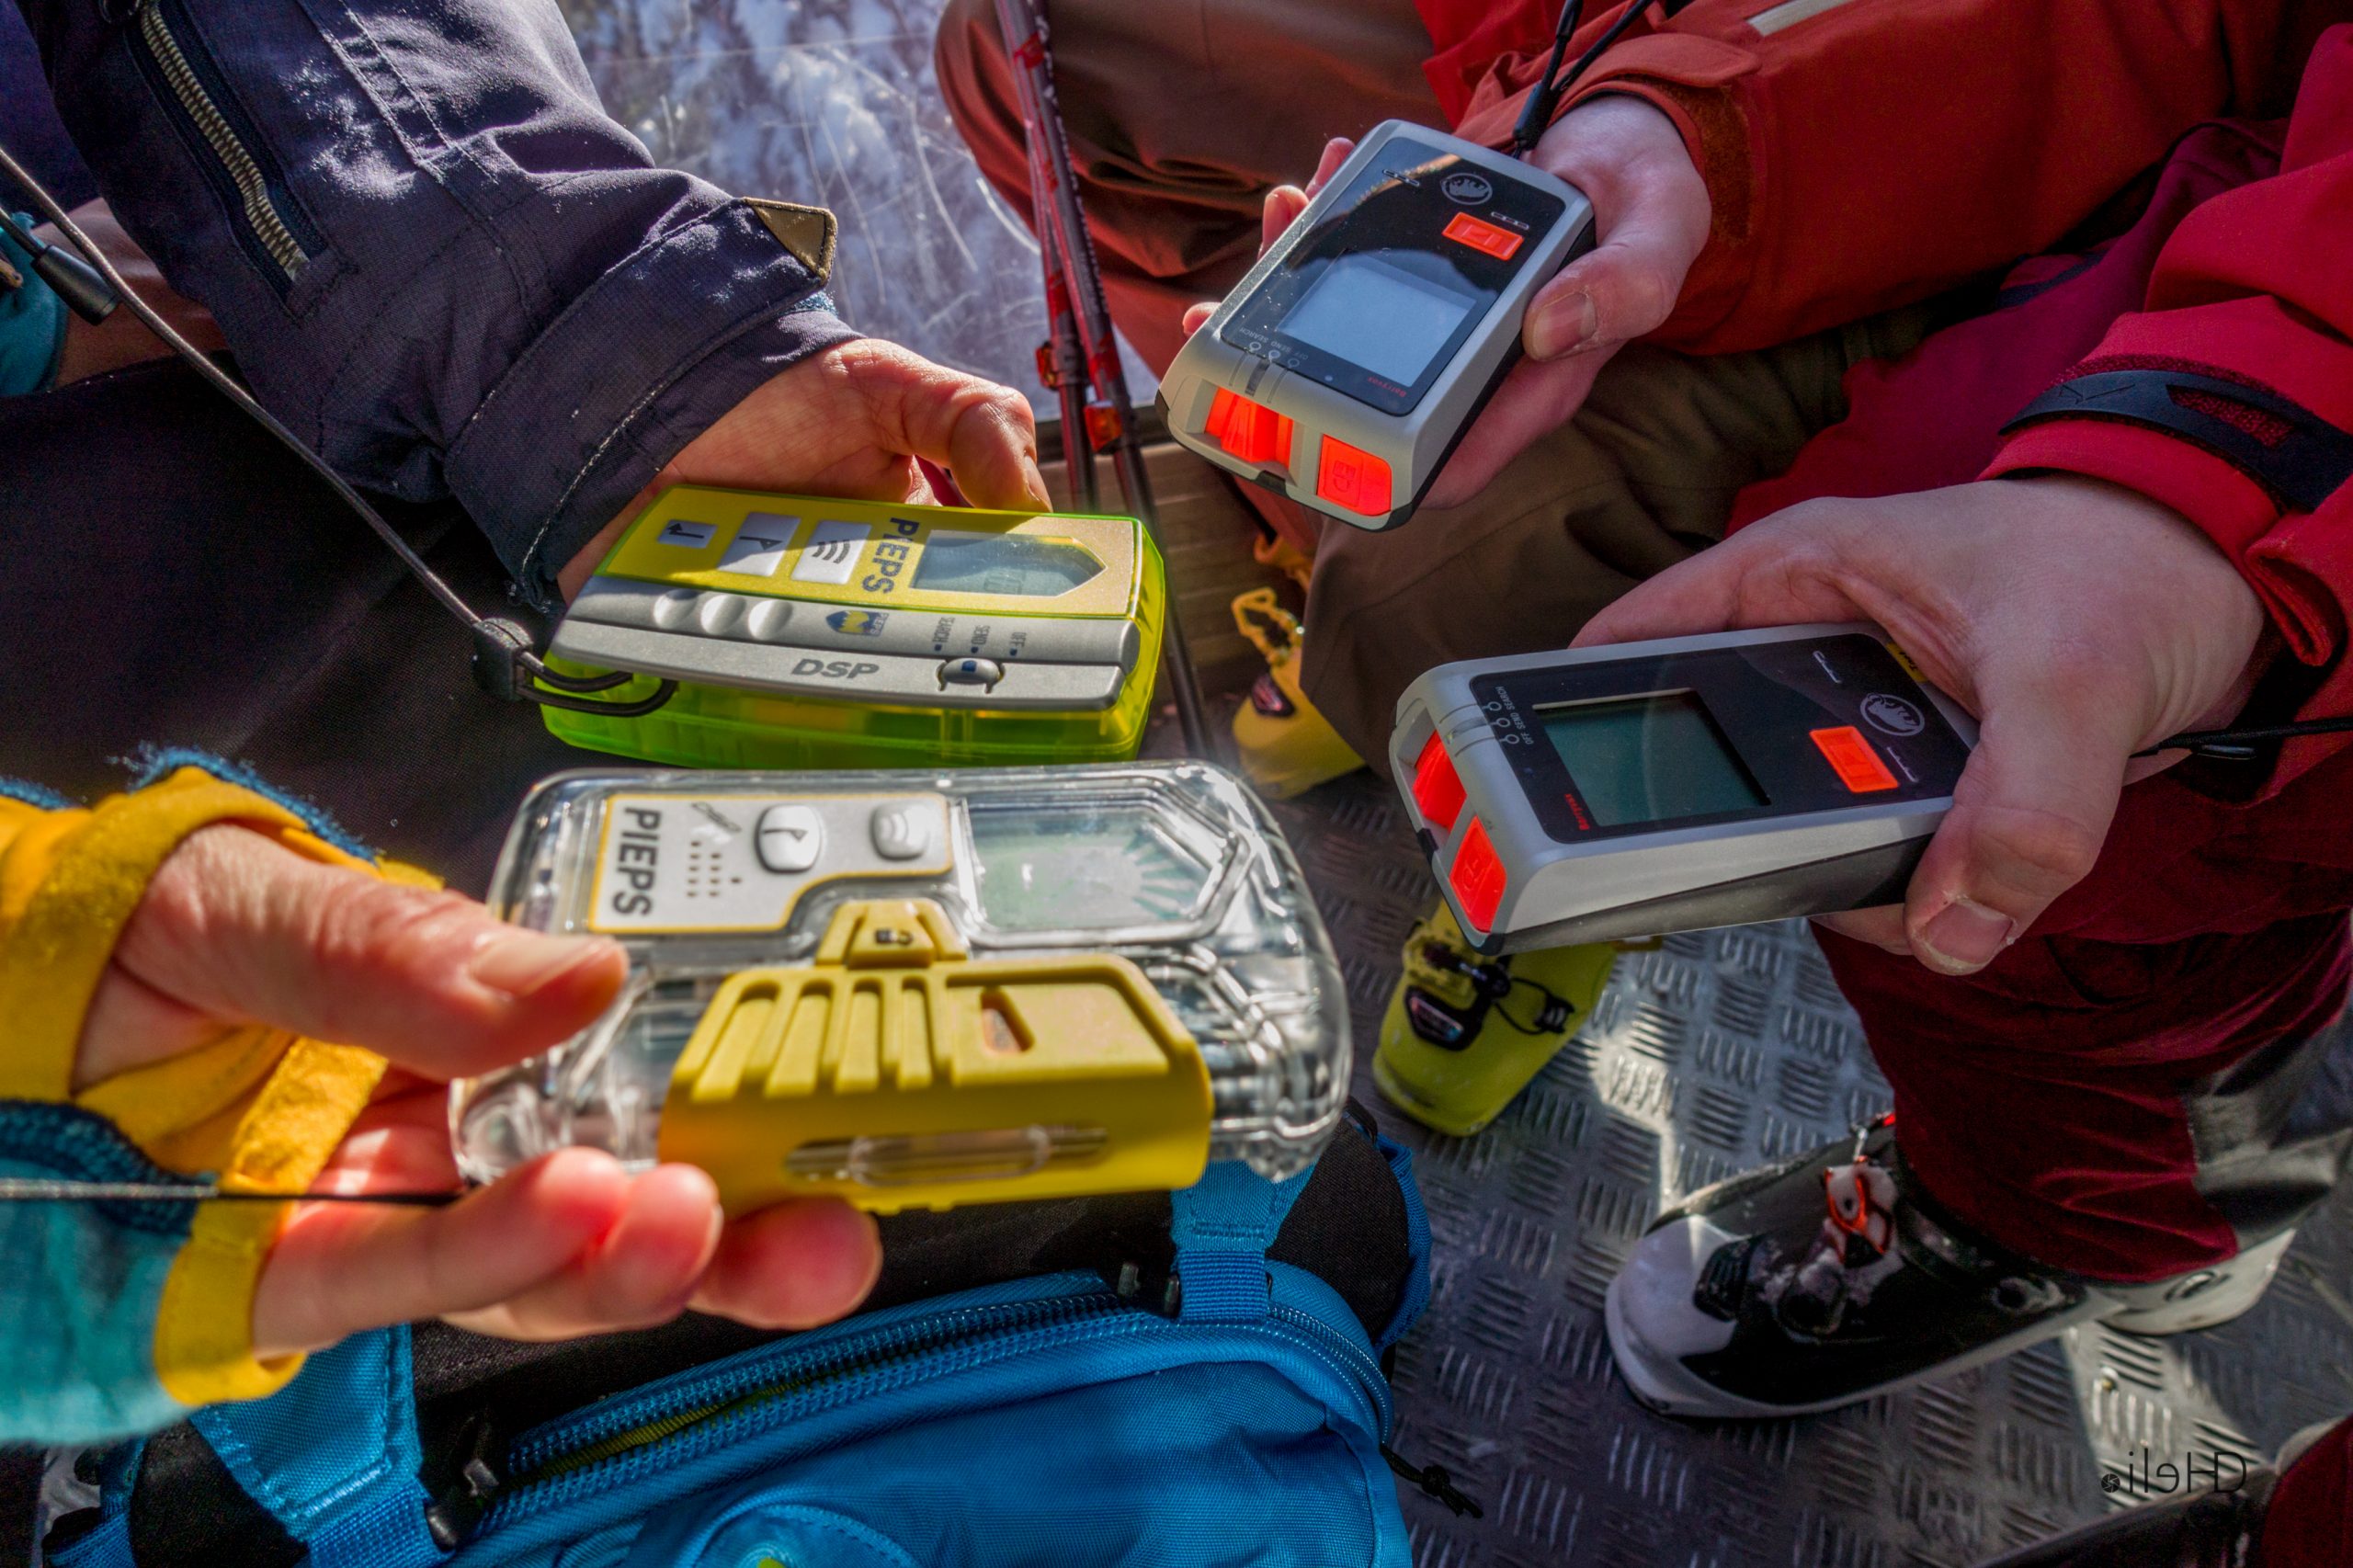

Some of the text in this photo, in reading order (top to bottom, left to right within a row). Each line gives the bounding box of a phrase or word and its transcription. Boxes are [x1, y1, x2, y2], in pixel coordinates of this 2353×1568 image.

[1239, 327, 1269, 343] SEARCH
[862, 517, 920, 594] PIEPS
[971, 625, 991, 645] SEND
[791, 658, 880, 679] DSP
[1495, 686, 1534, 744] OFF SEND SEARCH
[612, 806, 661, 915] PIEPS
